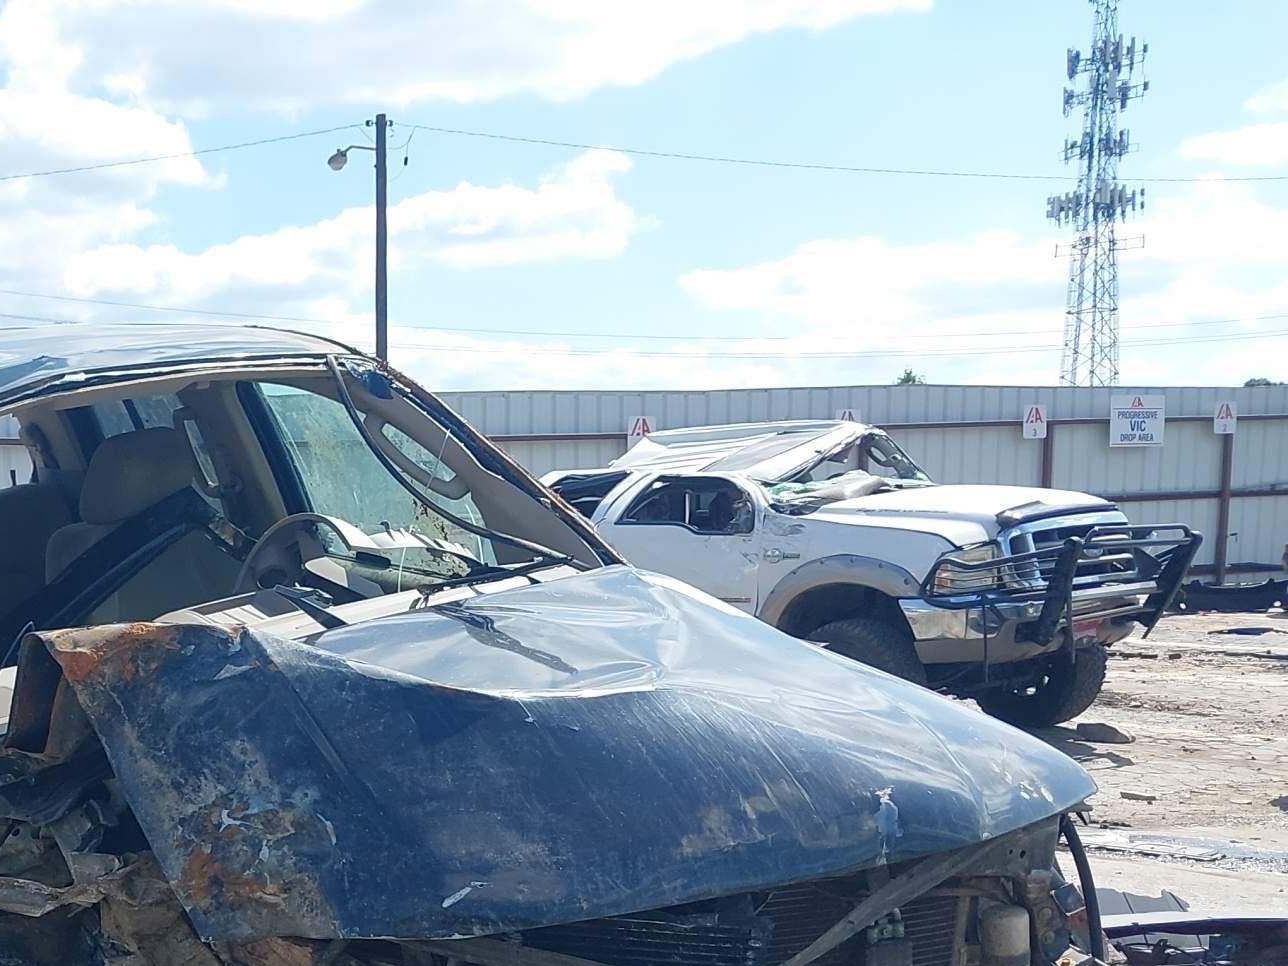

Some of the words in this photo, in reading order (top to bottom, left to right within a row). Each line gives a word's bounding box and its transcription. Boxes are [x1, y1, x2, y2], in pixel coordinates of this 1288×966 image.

[1129, 420, 1147, 432] VIC
[1119, 433, 1137, 442] DROP
[1138, 433, 1154, 442] AREA
